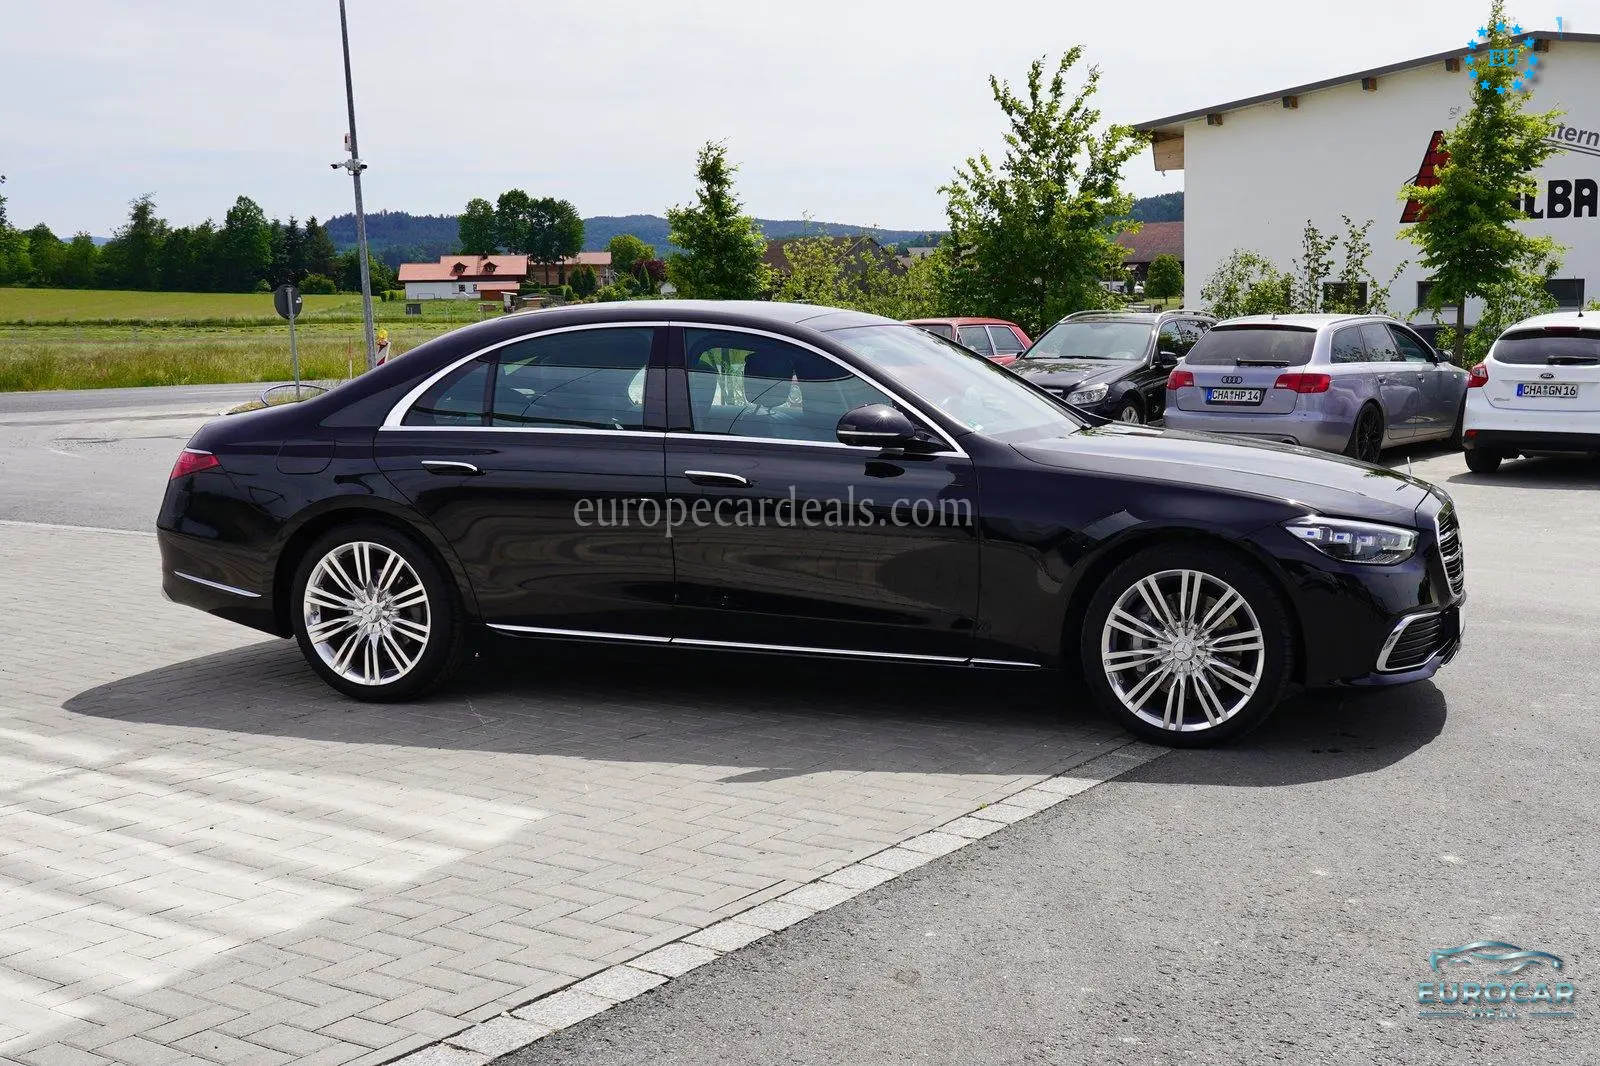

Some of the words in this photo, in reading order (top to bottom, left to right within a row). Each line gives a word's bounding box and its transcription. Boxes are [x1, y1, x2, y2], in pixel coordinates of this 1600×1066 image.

[1212, 390, 1229, 400] CHA
[1234, 390, 1247, 400] HP
[1248, 390, 1259, 401] 14
[1523, 385, 1542, 395] CHA
[1548, 385, 1562, 396] GN
[1563, 386, 1576, 396] 16
